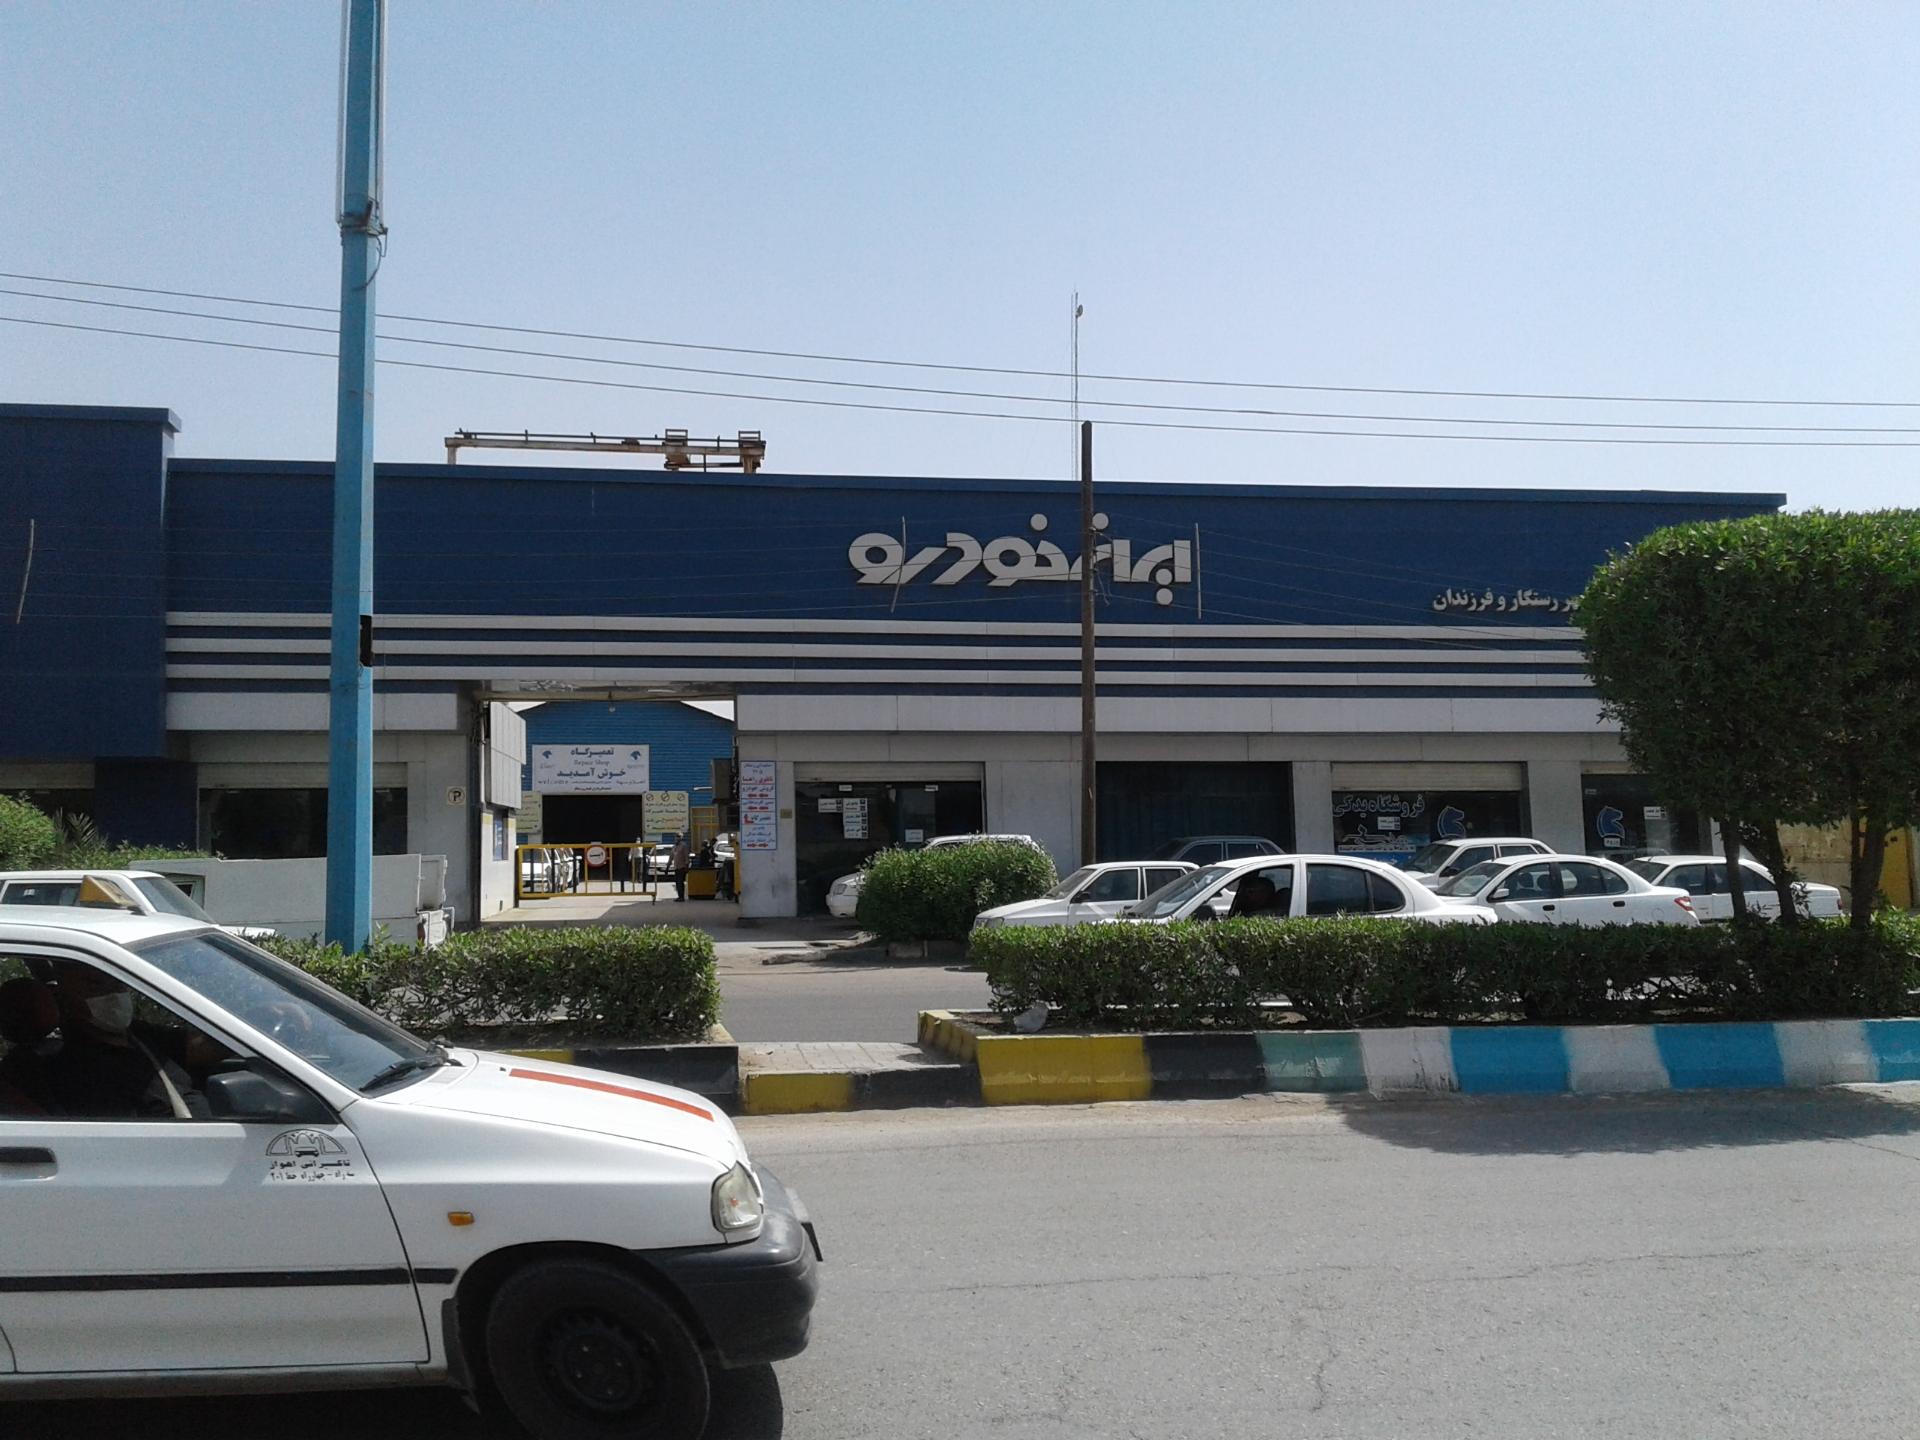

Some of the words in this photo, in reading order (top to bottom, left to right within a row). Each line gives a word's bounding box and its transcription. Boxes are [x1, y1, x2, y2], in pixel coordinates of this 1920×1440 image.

[1433, 588, 1494, 611] فرزندان
[1496, 595, 1506, 611] و
[1508, 589, 1558, 612] رستگار
[557, 767, 595, 778] آمدید
[597, 768, 626, 779] خوش
[1368, 793, 1425, 818] فروشگاه
[270, 1160, 297, 1170] اهواز
